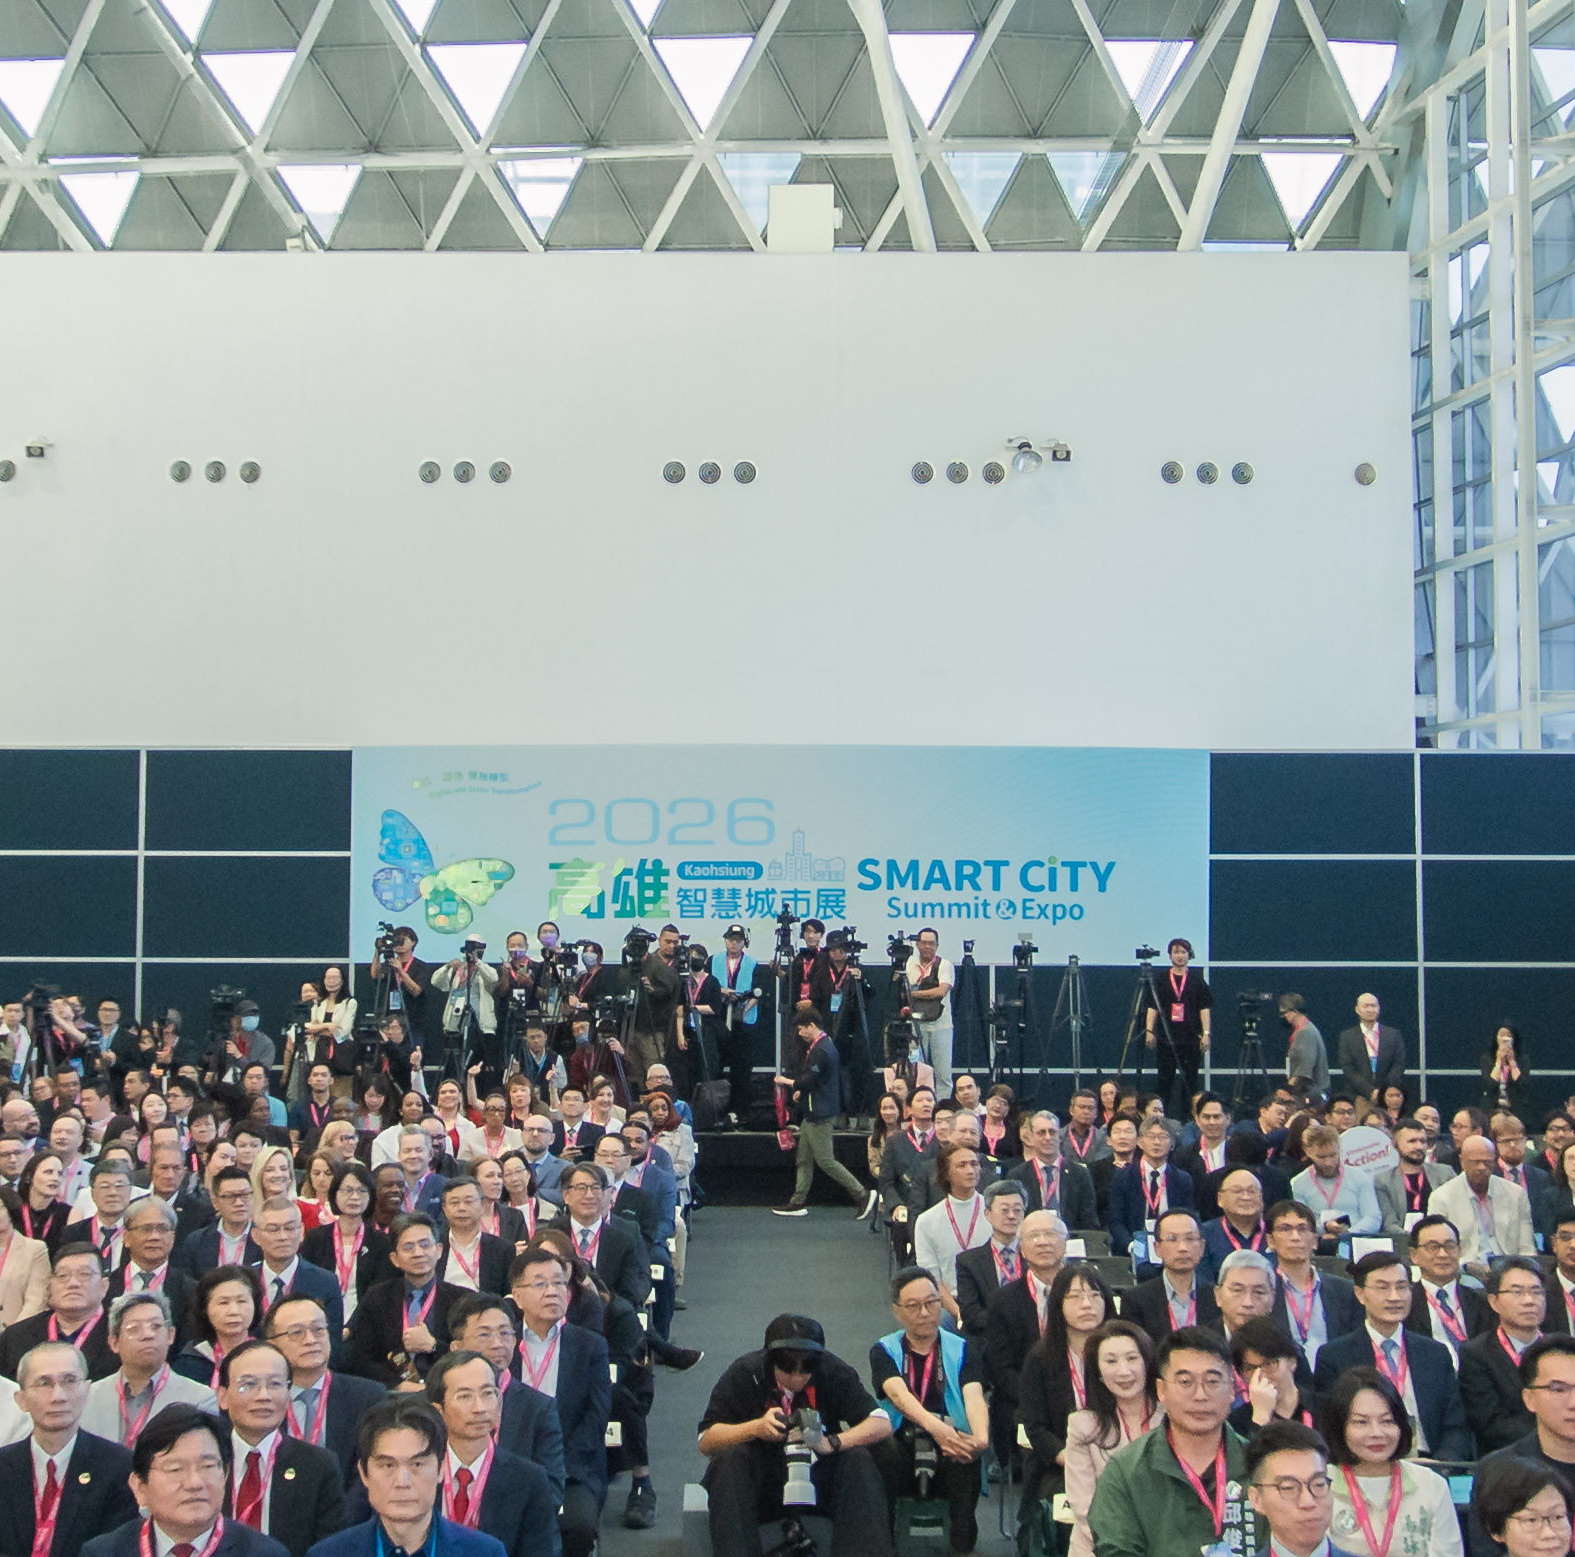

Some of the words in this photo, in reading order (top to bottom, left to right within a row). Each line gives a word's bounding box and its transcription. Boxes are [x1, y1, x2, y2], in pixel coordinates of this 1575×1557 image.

[548, 797, 776, 846] 2026
[683, 863, 756, 880] Kaohsiung
[857, 858, 1011, 892] SMART
[548, 857, 671, 921] 高雄
[676, 886, 847, 920] 智慧城市展
[886, 896, 992, 920] Summit
[1022, 898, 1085, 926] Expo
